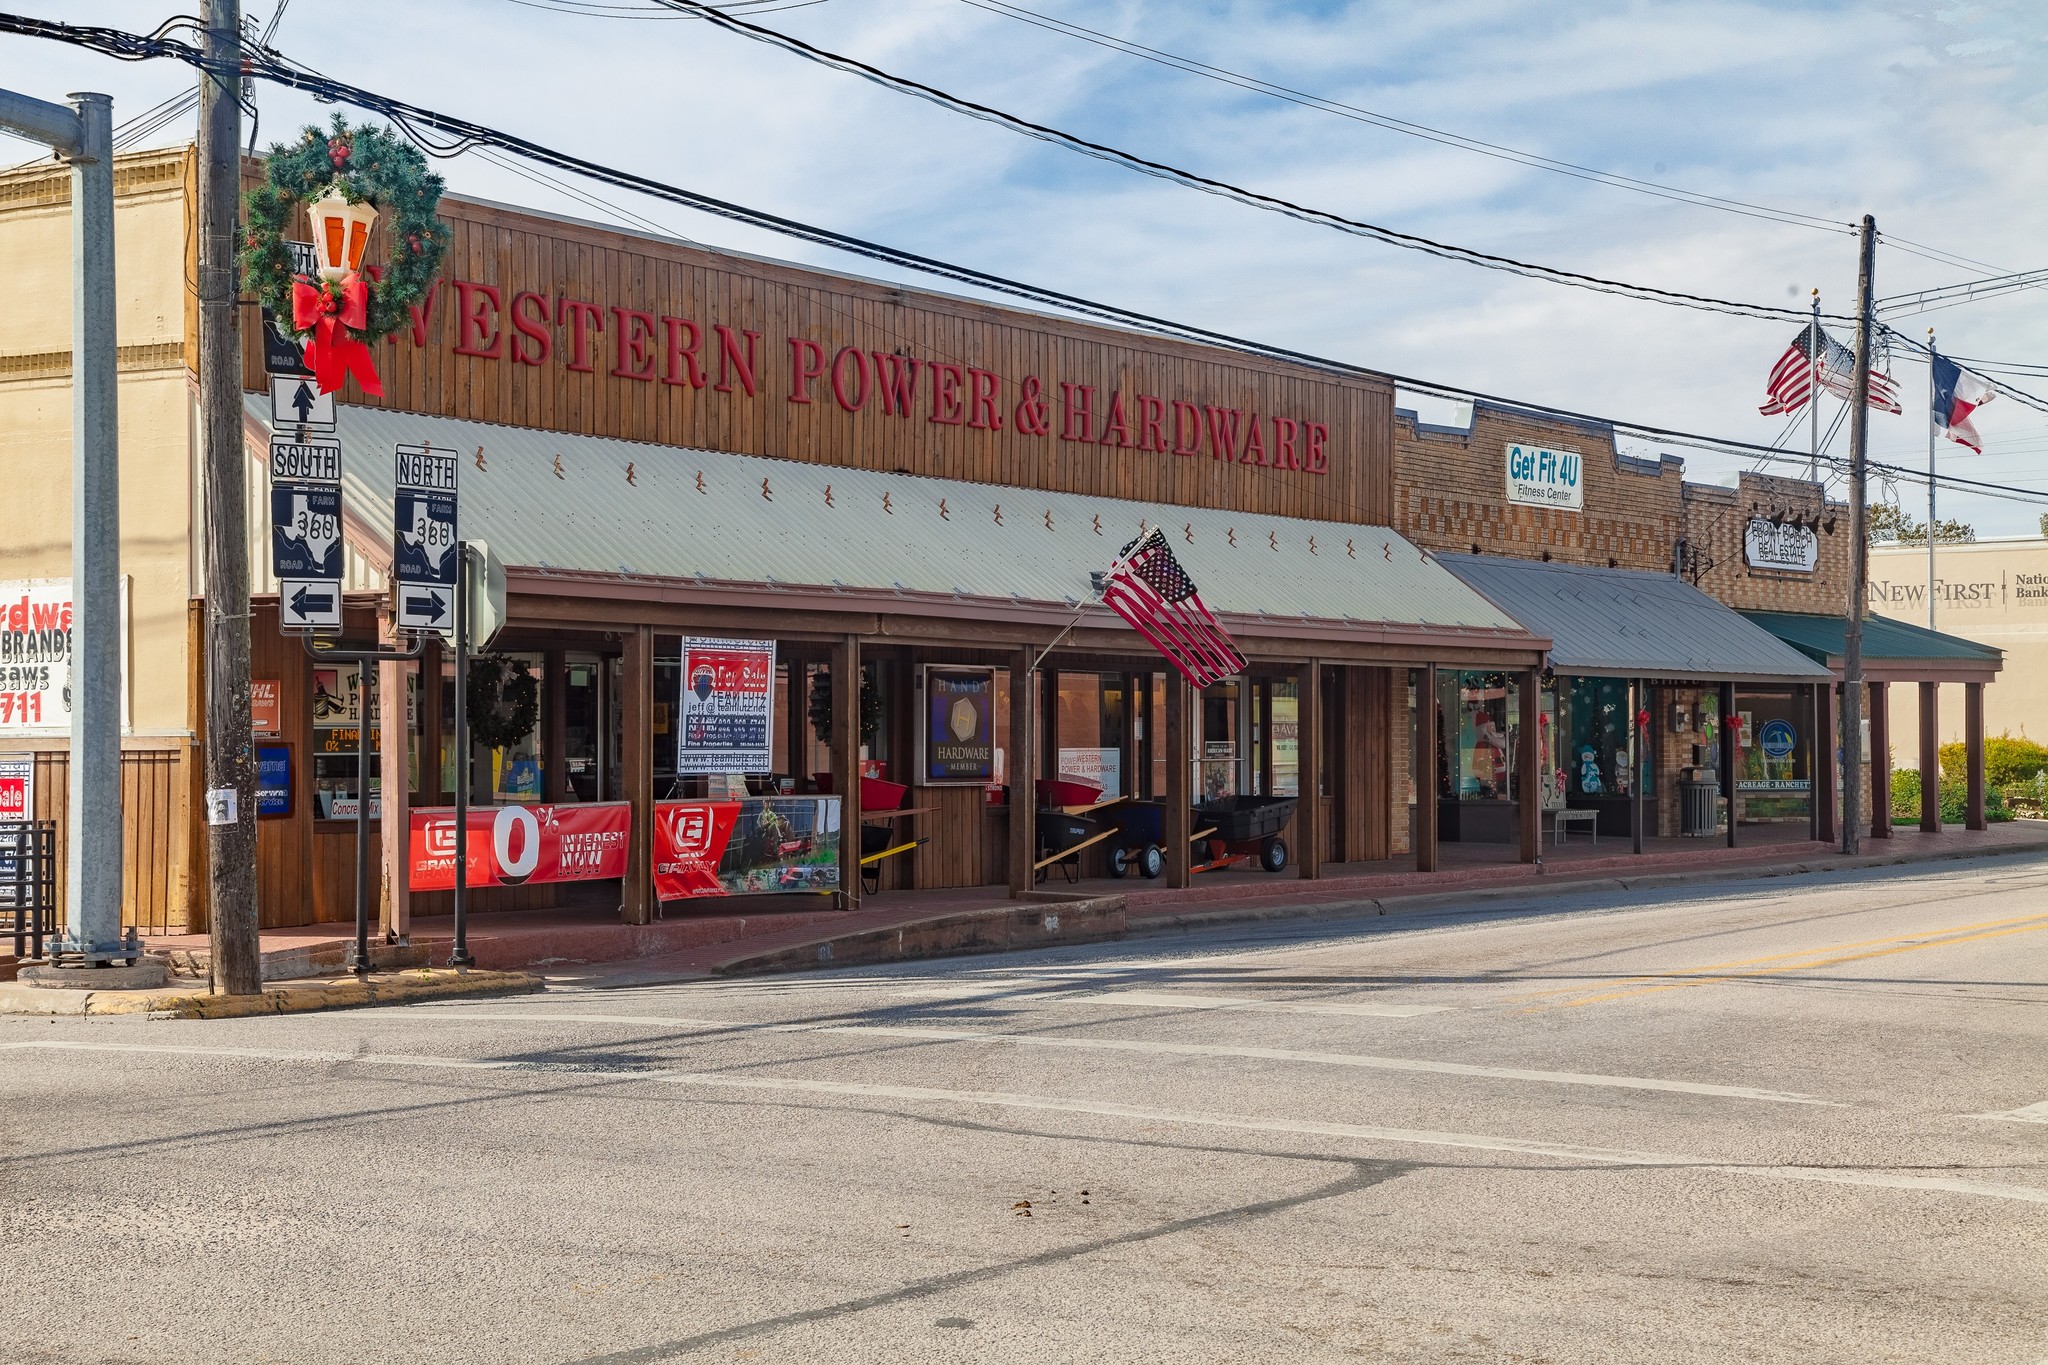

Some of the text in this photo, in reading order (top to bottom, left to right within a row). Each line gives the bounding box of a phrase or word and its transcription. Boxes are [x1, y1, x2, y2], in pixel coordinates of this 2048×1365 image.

[271, 356, 295, 367] ROAD
[789, 337, 1004, 432] POWER
[1015, 376, 1050, 437] &
[1060, 381, 1330, 475] HARDWARE
[274, 446, 336, 478] SOUTH
[400, 454, 454, 489] NORTH
[1510, 447, 1579, 487] Get Fit 4U
[312, 496, 335, 506] FARM
[1517, 484, 1571, 501] Fitness Center
[431, 504, 452, 514] FARM
[297, 511, 334, 540] 360
[416, 518, 449, 546] 360
[1783, 525, 1813, 548] PORCH
[1758, 542, 1806, 563] REAL ESTATE
[280, 560, 304, 570] ROAD
[400, 563, 422, 574] ROAD
[938, 680, 990, 694] HANDY
[938, 747, 989, 760] HARDWARE
[1061, 765, 1080, 773] POWER
[1087, 764, 1117, 773] HARDWARE
[1738, 781, 1810, 789] ACREAGE RANCHET
[0, 785, 22, 807] ale
[333, 802, 358, 815] Concre
[560, 832, 627, 853] INTEREST
[558, 850, 603, 876] NOW
